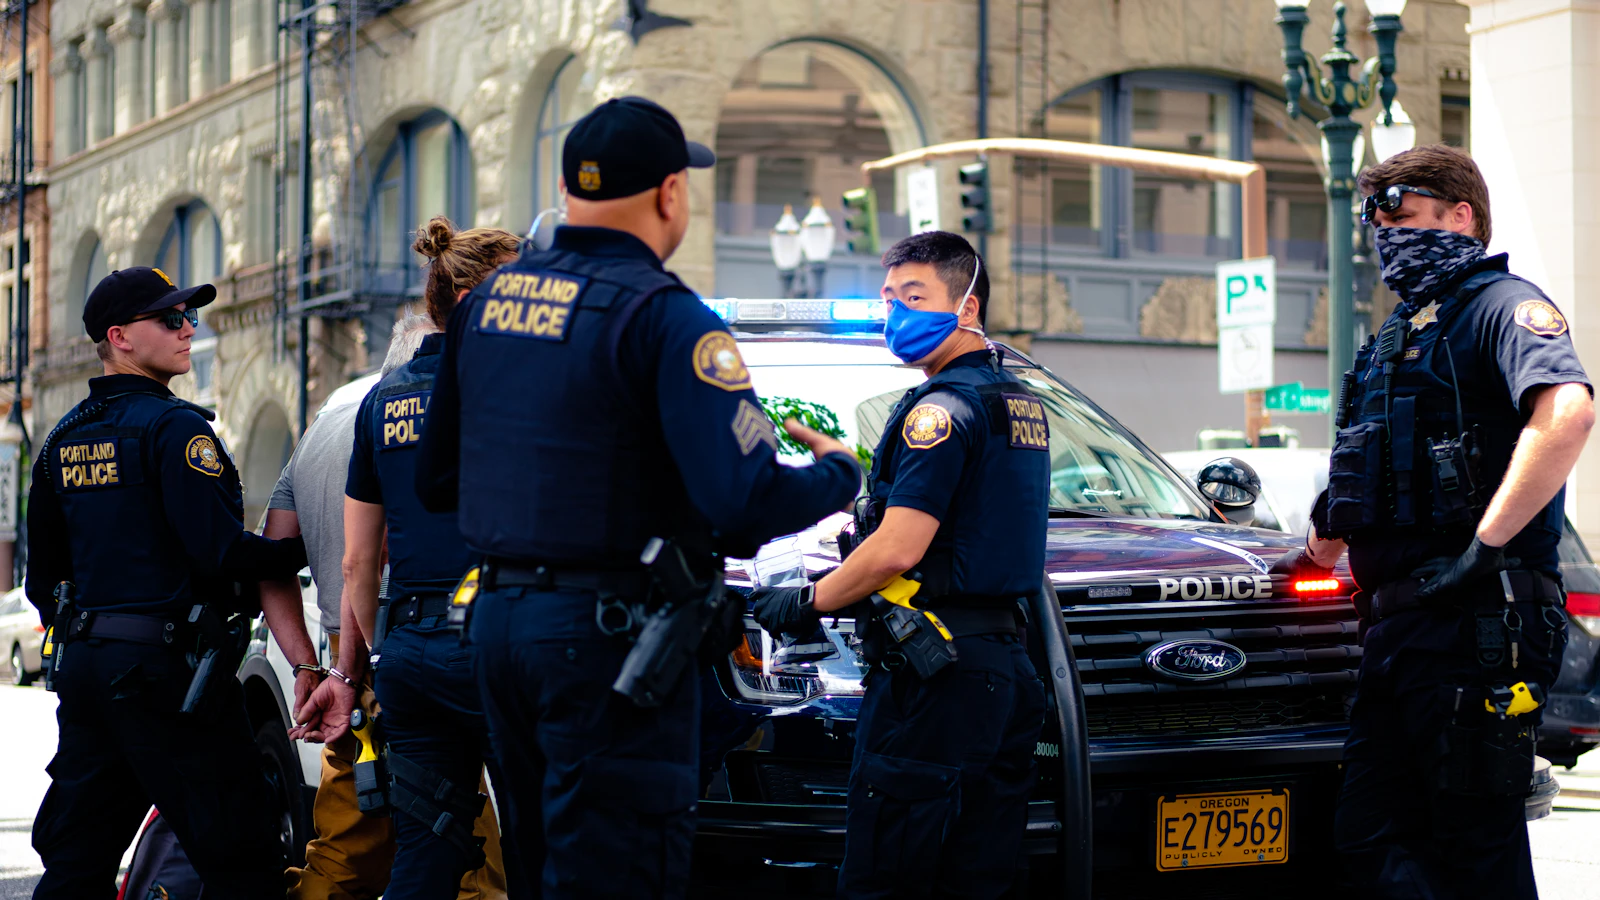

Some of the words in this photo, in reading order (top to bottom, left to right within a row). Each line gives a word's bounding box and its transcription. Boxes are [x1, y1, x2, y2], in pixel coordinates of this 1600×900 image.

[490, 272, 580, 304] PORTLAND
[1226, 275, 1248, 314] P
[480, 299, 570, 337] POLICE
[384, 396, 431, 420] PORTL
[1007, 398, 1043, 421] PORTLAND
[384, 418, 424, 446] POL
[909, 430, 938, 442] PORTLAND
[1011, 420, 1048, 447] POLICE
[60, 442, 115, 464] PORTLAND
[61, 461, 119, 488] POLICE
[1157, 575, 1273, 601] POLICE
[1174, 645, 1233, 672] Ford
[1034, 741, 1059, 758] 80004
[1200, 797, 1250, 809] OREGON
[1164, 806, 1283, 851] E279569
[1165, 850, 1223, 860] PUBLICLY
[1243, 846, 1283, 855] OWNED
